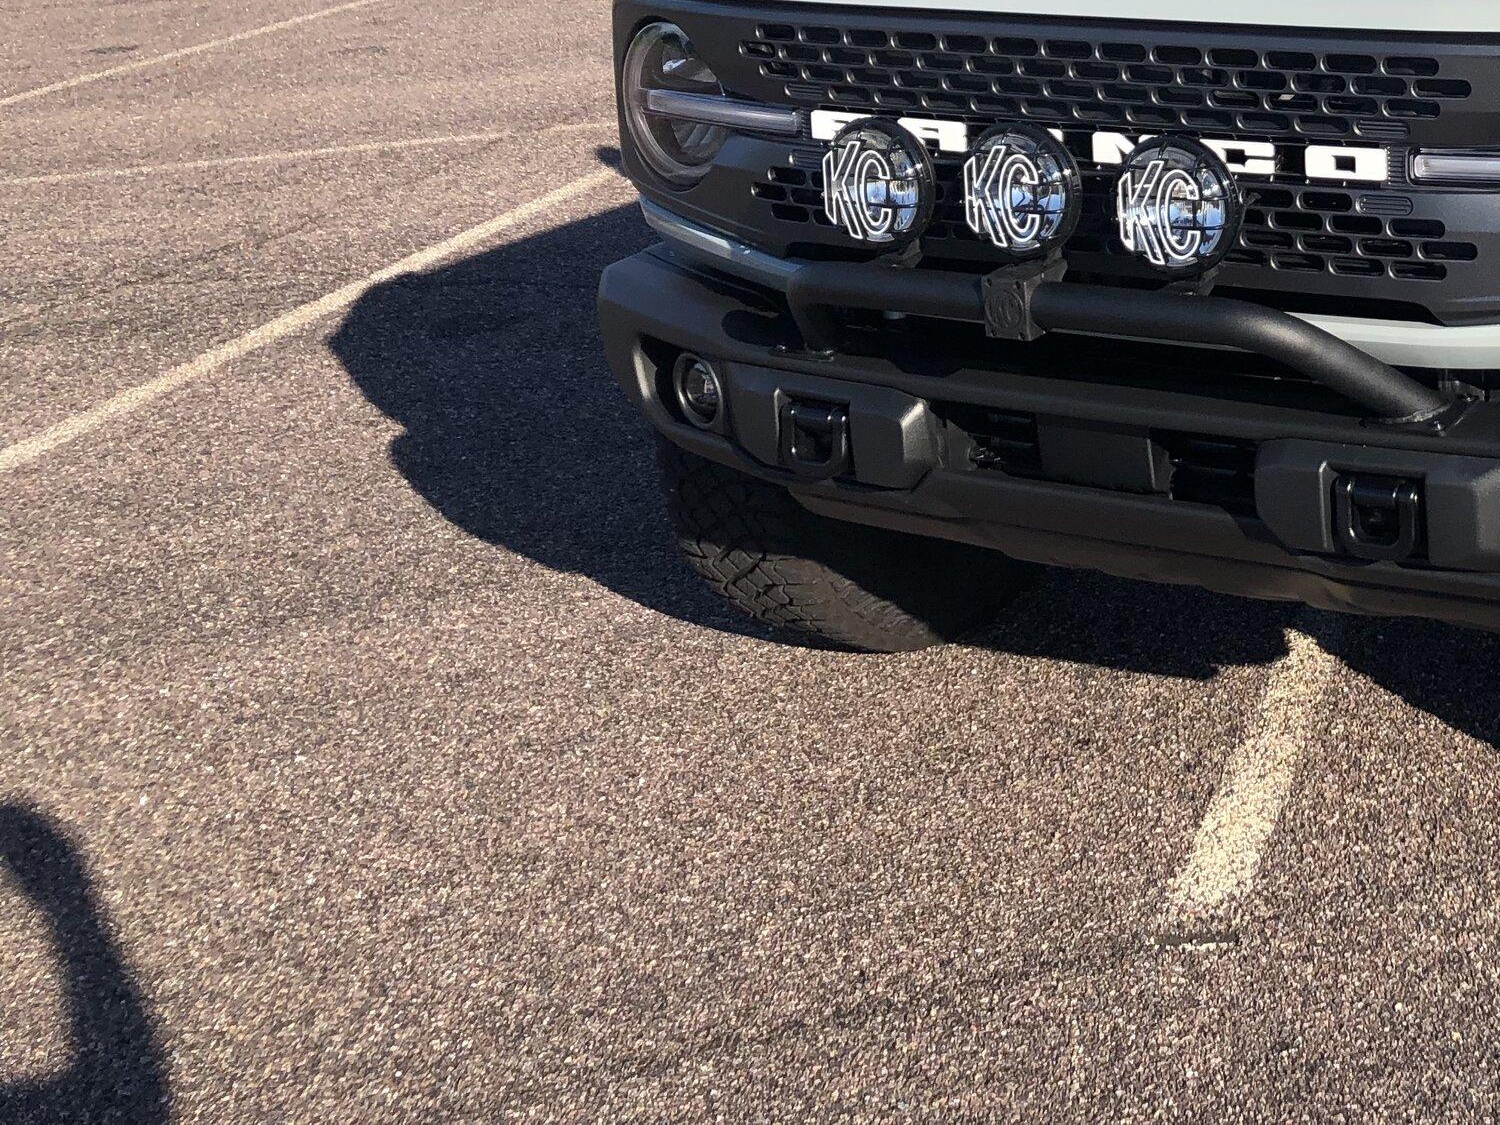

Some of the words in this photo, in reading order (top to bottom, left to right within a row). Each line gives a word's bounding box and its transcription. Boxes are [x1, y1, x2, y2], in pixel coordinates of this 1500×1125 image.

[822, 140, 892, 239] KC
[963, 145, 1040, 248] KC
[1117, 159, 1201, 265] KC
